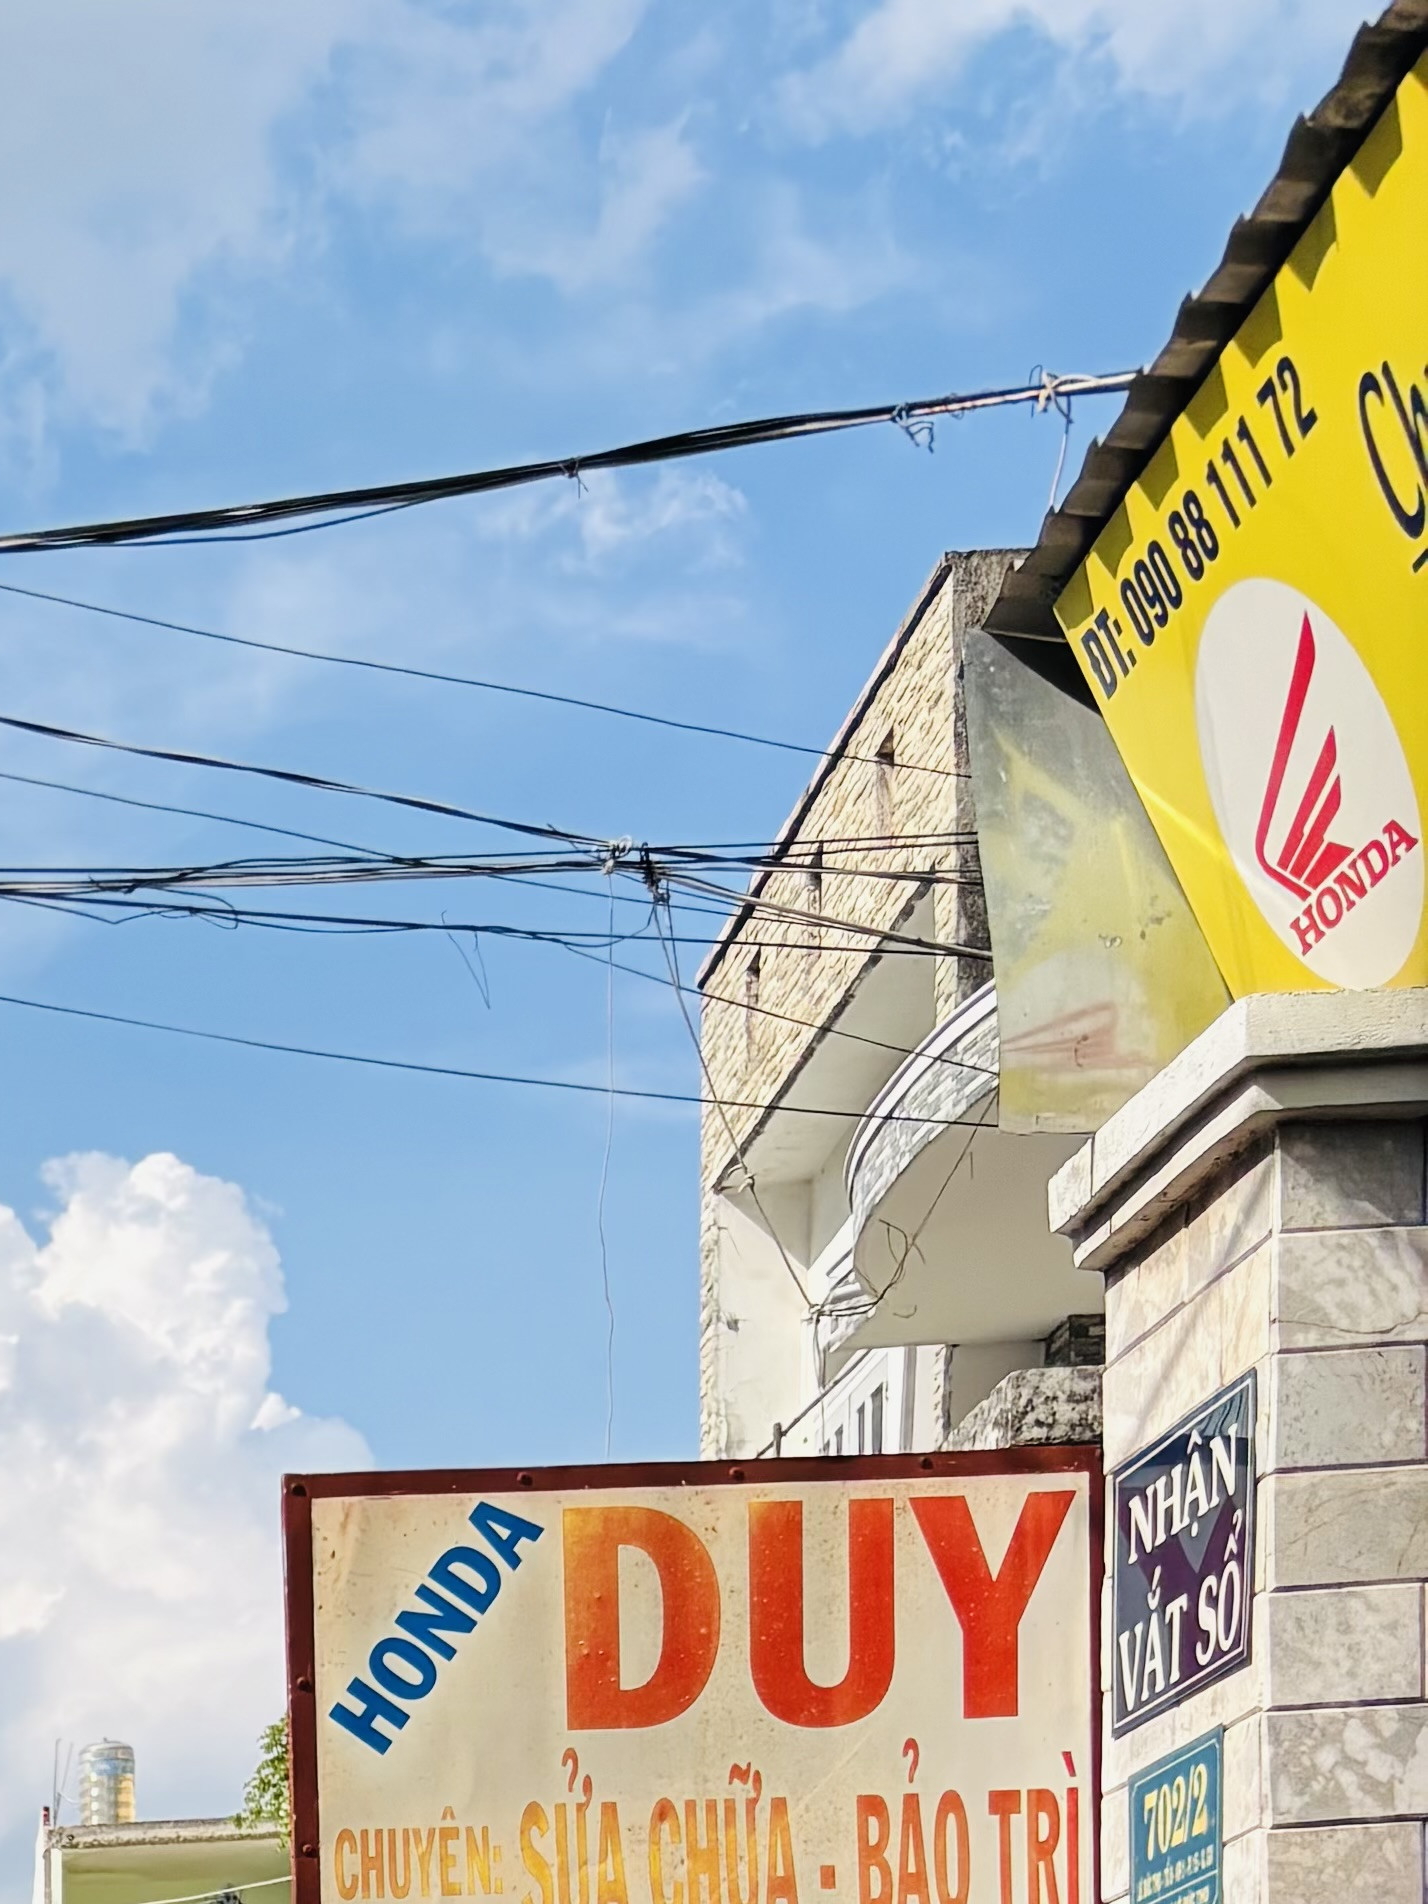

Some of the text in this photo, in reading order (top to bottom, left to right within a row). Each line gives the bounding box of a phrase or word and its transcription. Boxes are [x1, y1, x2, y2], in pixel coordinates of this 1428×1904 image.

[1120, 539, 1183, 646] 090
[1167, 489, 1219, 581] 88
[1206, 414, 1273, 530] 111
[1256, 355, 1319, 459] 72
[1289, 819, 1419, 957] HONDA
[1127, 1422, 1238, 1565] NHẬN
[328, 1500, 545, 1756] HONDA
[562, 1490, 1077, 1731] DUY
[1118, 1508, 1243, 1712] VẮT SỔ
[334, 1805, 504, 1900] CHUYÊN:
[1144, 1763, 1208, 1861] 702/2
